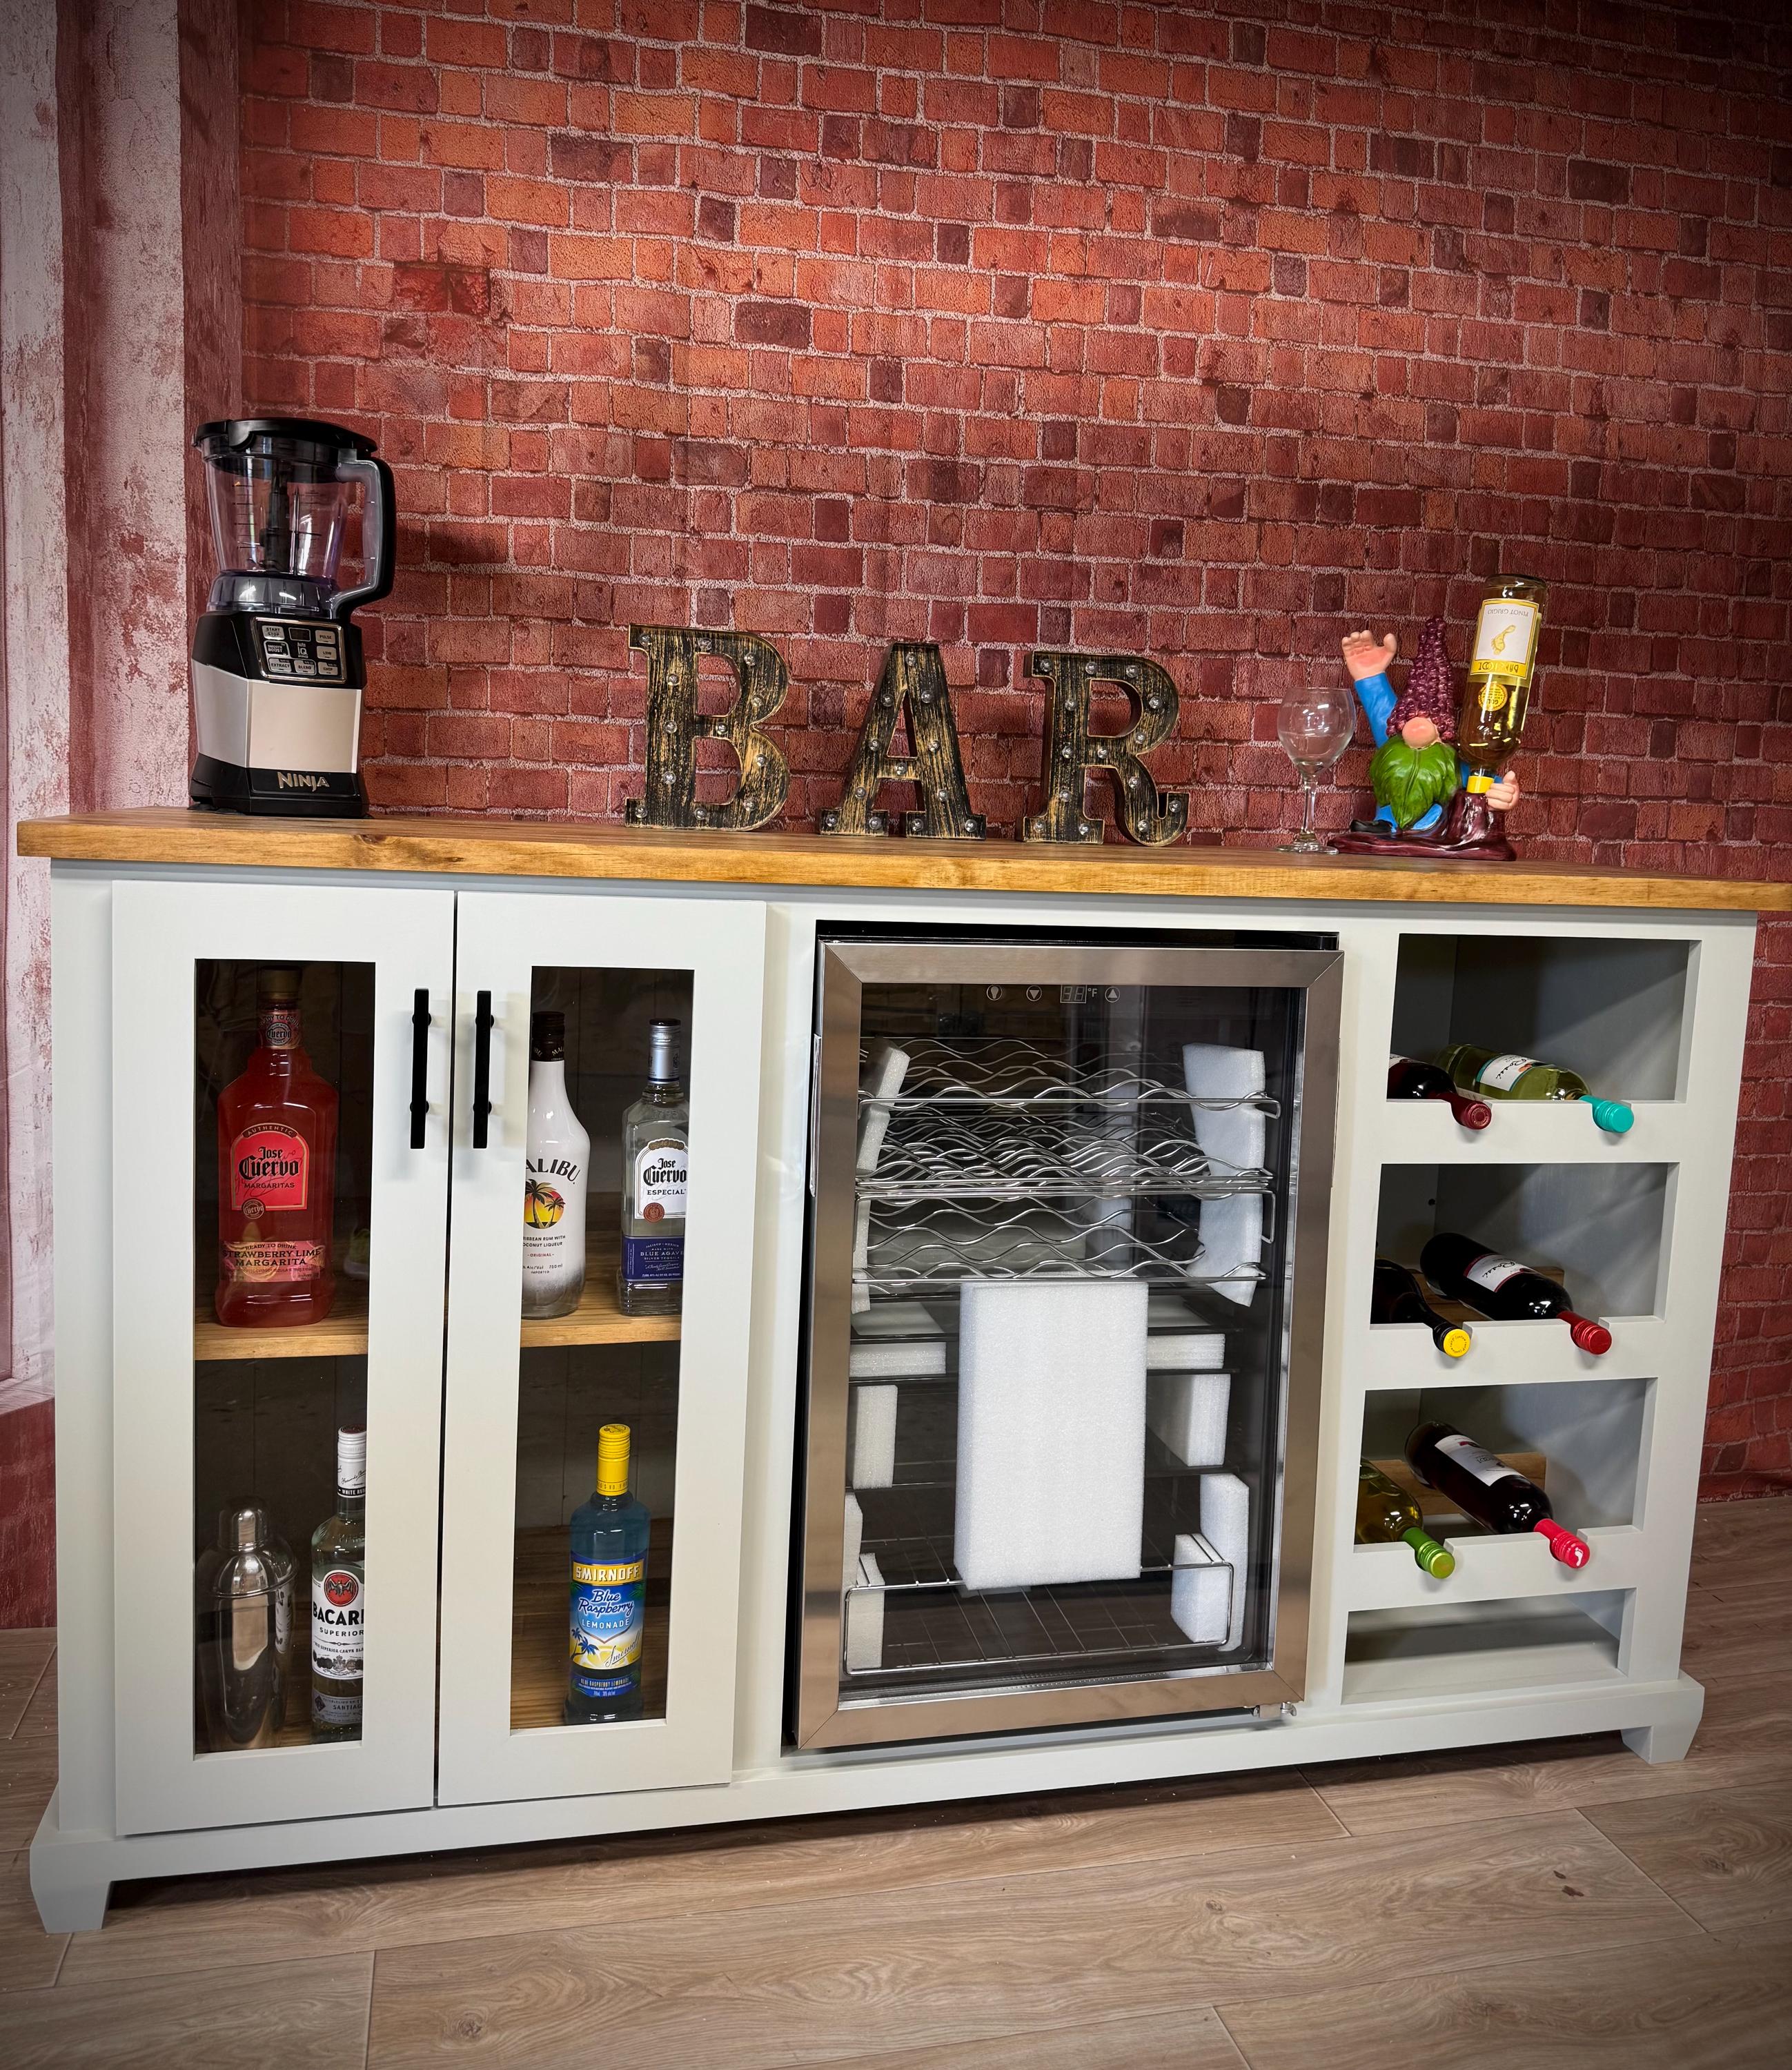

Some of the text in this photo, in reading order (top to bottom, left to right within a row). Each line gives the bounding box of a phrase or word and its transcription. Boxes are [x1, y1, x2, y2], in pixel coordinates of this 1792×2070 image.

[1510, 609, 1529, 617] PINOT
[625, 624, 1190, 847] BAR
[277, 771, 330, 792] NINJA
[248, 1125, 293, 1136] AUTHENTIC
[258, 1146, 283, 1160] Jose
[238, 1155, 299, 1181] Cuervo
[658, 1158, 676, 1170] Jose
[643, 1165, 687, 1187] Cuervo
[224, 1250, 293, 1258] STRAWBERRY
[235, 1258, 307, 1266] MARGARITA
[575, 1565, 640, 1581] SMIRNOFF
[592, 1590, 620, 1602] Blue
[579, 1598, 634, 1617] Raspberry
[582, 1619, 629, 1629] LEMONADE
